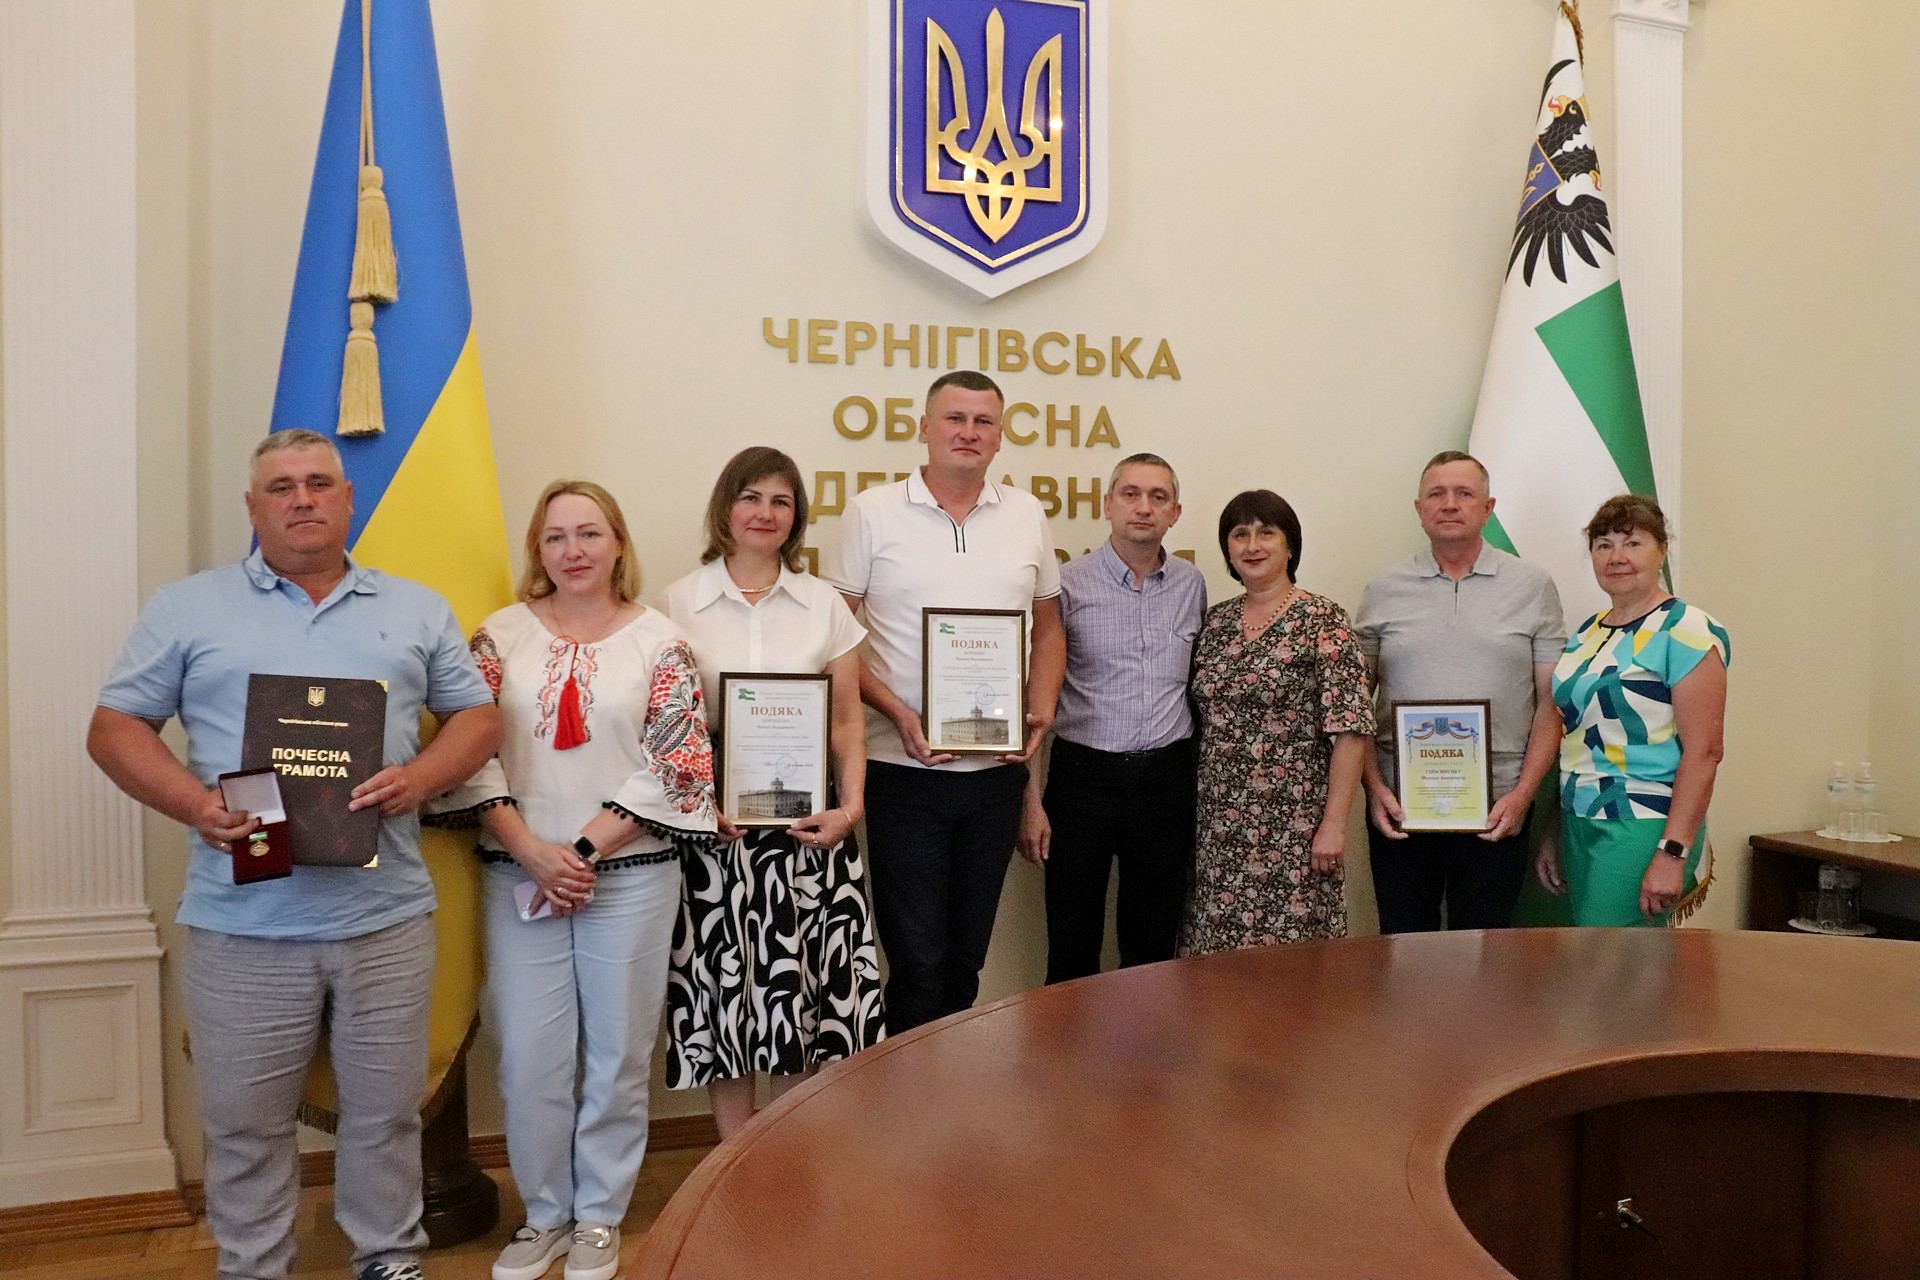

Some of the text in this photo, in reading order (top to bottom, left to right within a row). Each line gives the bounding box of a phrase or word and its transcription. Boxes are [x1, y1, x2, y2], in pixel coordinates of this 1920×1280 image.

[762, 316, 1182, 380] ЧЕРНІГІВСЬКА
[833, 395, 1121, 449] ОБСНА
[951, 639, 999, 650] ПОДЯКА
[750, 706, 803, 717] ПОДЯКА
[271, 747, 352, 763] ПОЧЕСНА
[1420, 748, 1465, 759] ПОДЯКА
